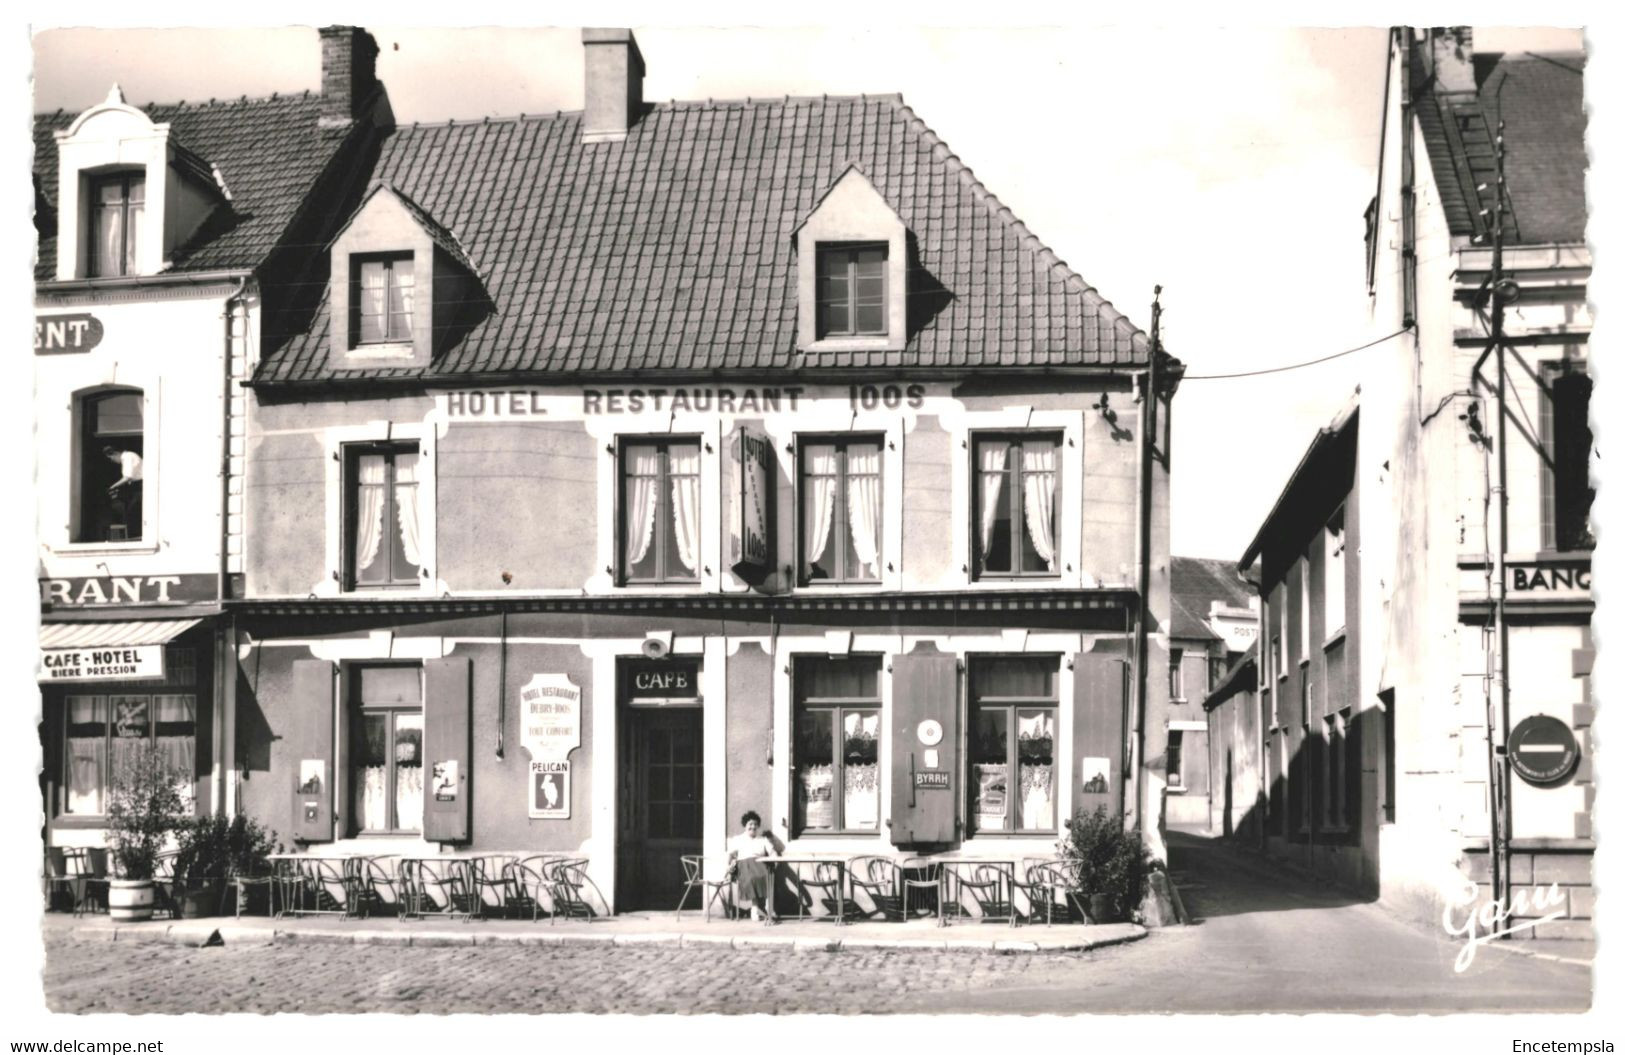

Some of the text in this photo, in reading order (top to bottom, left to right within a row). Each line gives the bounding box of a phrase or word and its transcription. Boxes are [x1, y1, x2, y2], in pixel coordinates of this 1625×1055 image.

[447, 389, 547, 416] HOTEL
[583, 386, 804, 415] RESTAURANT
[44, 653, 81, 668] CAFE
[92, 650, 143, 666] HOTEL
[51, 664, 137, 678] BIERE PRESSION
[635, 671, 688, 690] CAFE
[532, 762, 568, 772] PELICAN
[916, 772, 948, 785] BYRRH
